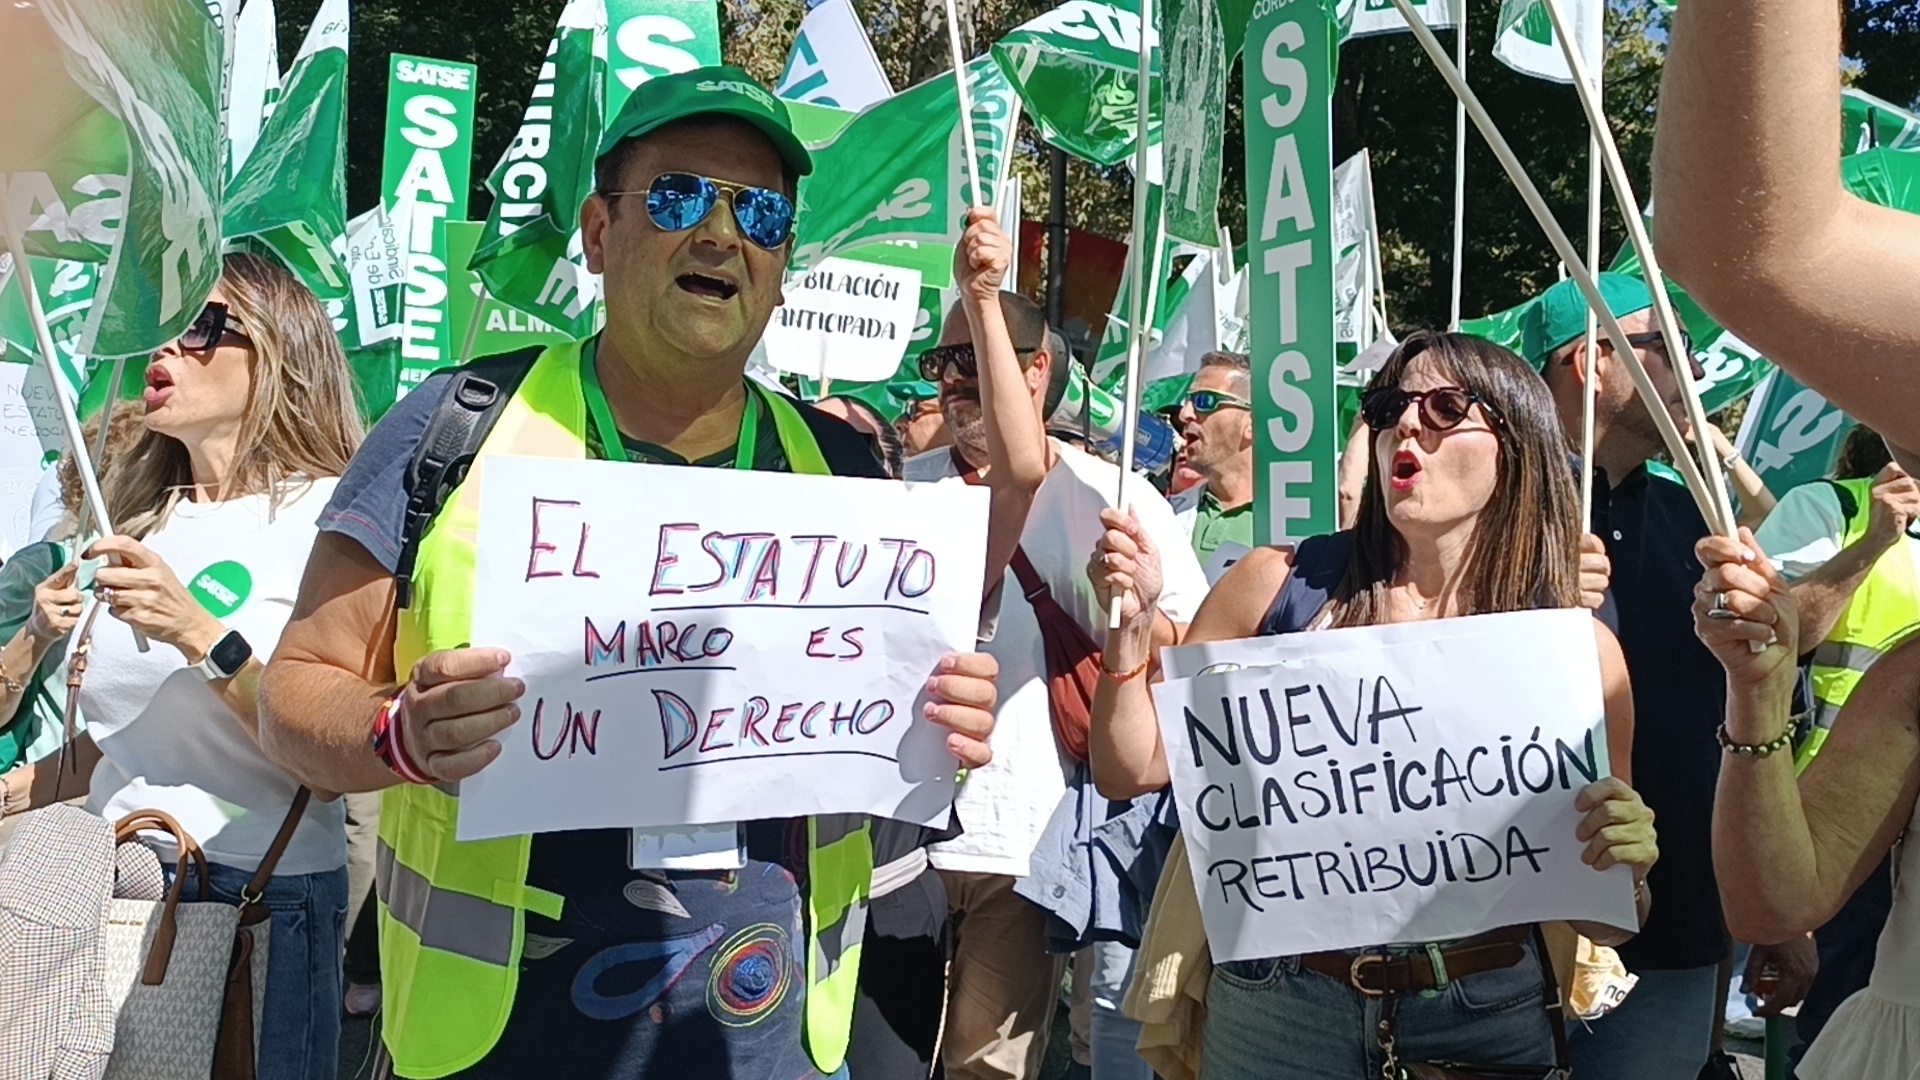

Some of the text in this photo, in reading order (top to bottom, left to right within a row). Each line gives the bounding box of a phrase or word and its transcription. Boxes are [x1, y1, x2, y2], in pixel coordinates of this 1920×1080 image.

[396, 60, 471, 91] SATSE
[696, 80, 775, 113] SATSE
[394, 94, 459, 361] SATSE
[784, 270, 900, 301] BILACIÓN
[1259, 20, 1316, 547] SATSE
[486, 309, 562, 333] ALM
[775, 307, 896, 341] ANTICIPADA
[525, 496, 937, 603] EL ESTATUTO
[584, 615, 866, 667] MARCO ES
[531, 688, 895, 760] UN DERECHO
[1183, 675, 1423, 768] NUEVA
